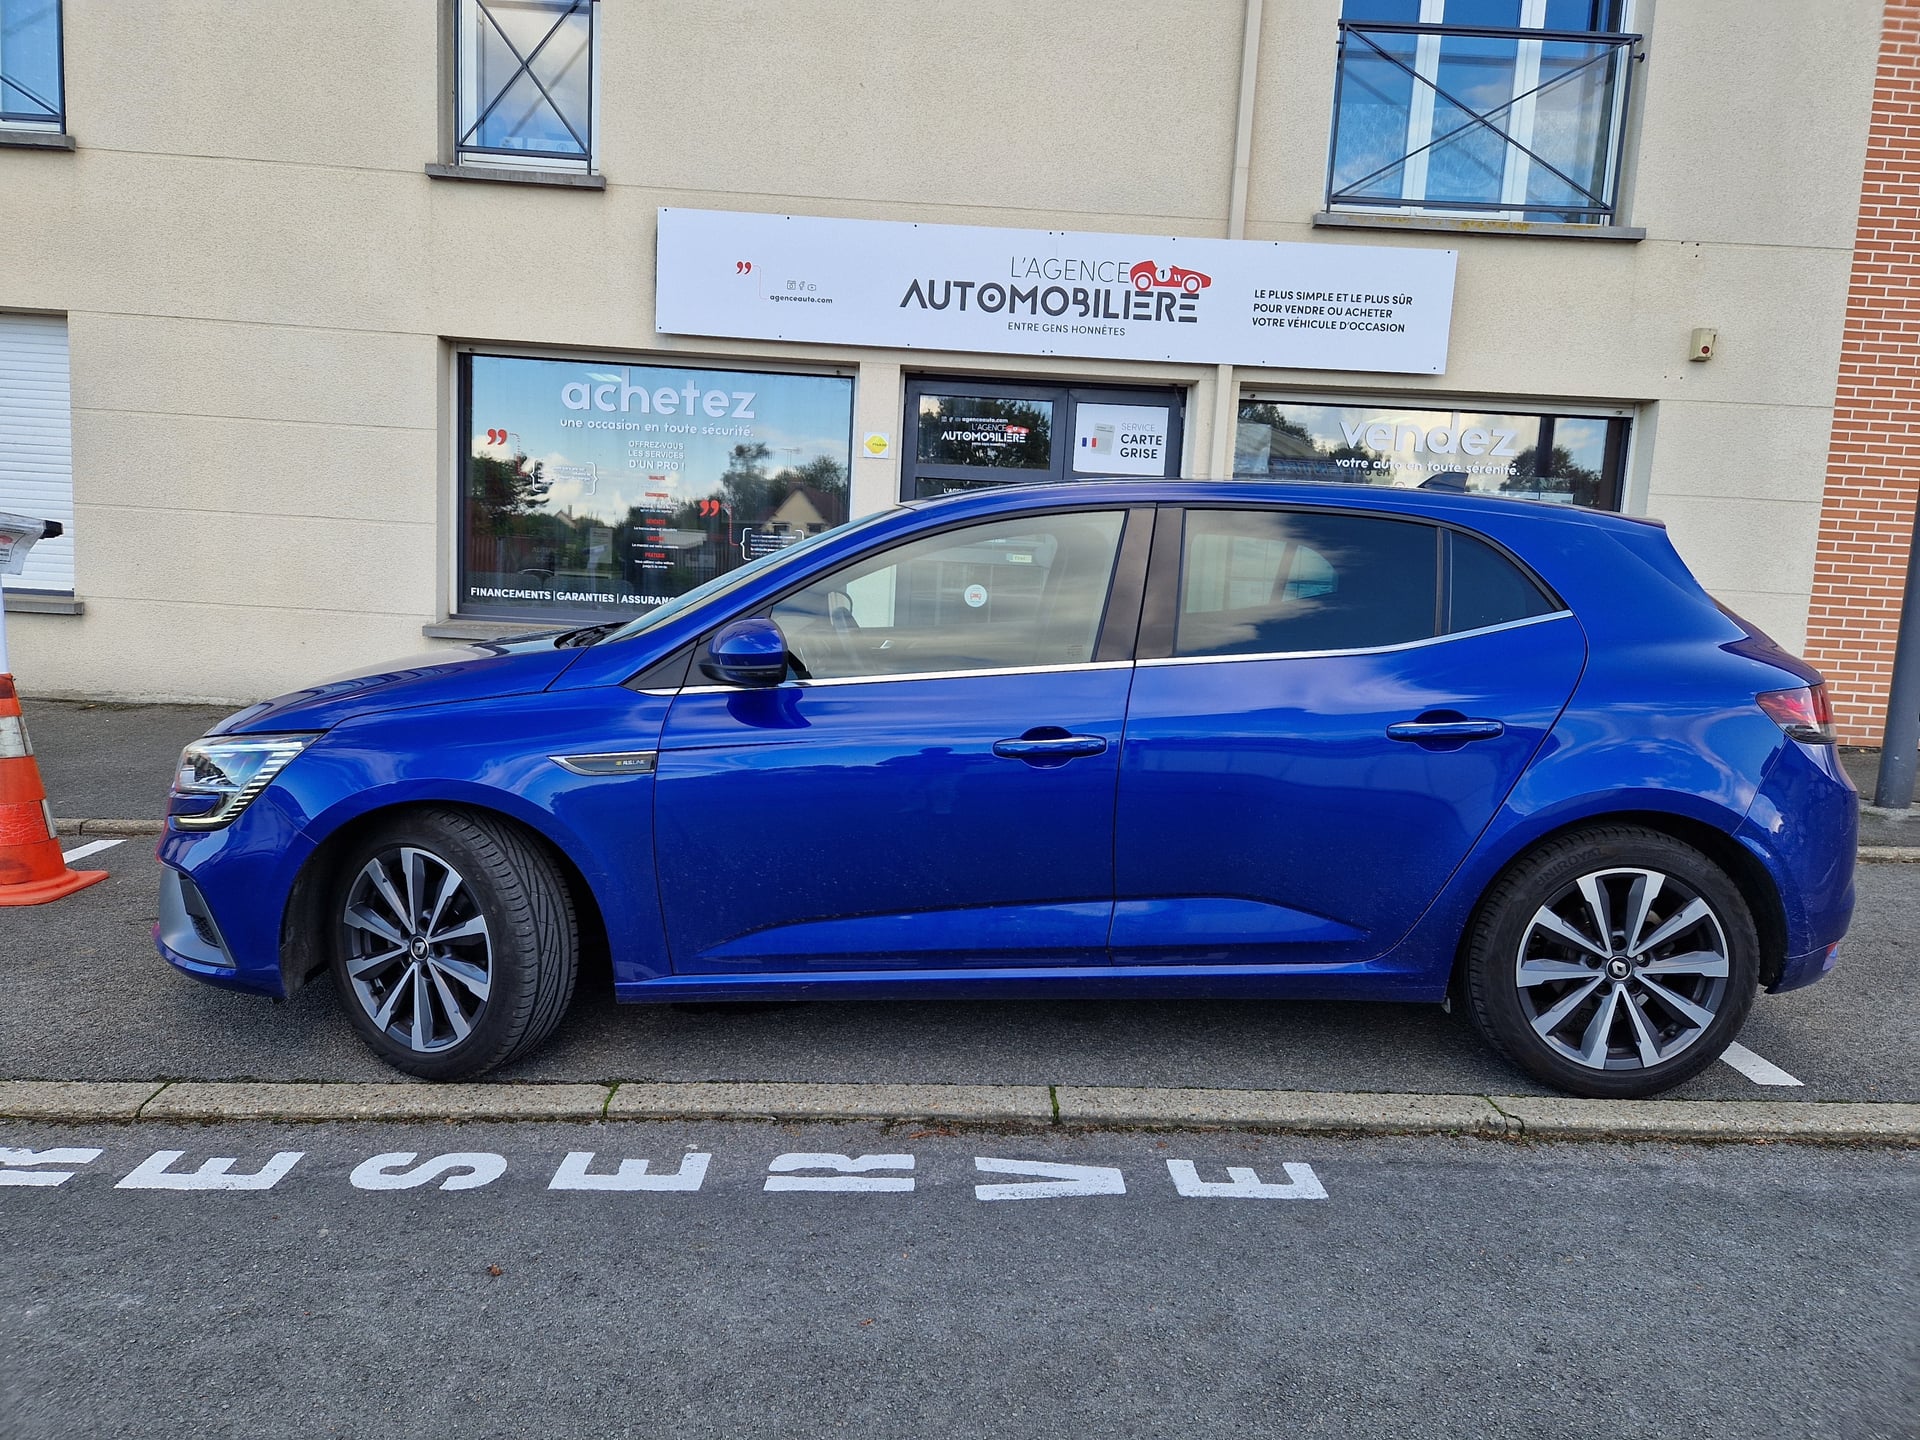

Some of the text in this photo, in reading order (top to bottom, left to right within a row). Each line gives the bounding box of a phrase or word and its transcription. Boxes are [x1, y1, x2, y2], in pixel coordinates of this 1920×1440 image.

[1011, 256, 1130, 284] L'AGENCE
[1159, 269, 1166, 279] 1
[769, 295, 833, 304] agenceauto.com
[1254, 289, 1413, 305] LE PLUS SIMPLE ET LE PLUS SÛR
[1253, 303, 1393, 318] POUR VENDRE OU ACHETER
[1008, 322, 1126, 336] ENTRE GENS HONNÊTES
[1252, 316, 1405, 333] VOTRE VÉHICULE D'OCCASION
[561, 367, 758, 419] achetez
[560, 418, 755, 437] une occasion en toute sécurité.
[971, 423, 1007, 432] L'AGENCE
[1121, 422, 1156, 431] SERVICE
[1339, 410, 1520, 457] vendez
[628, 440, 684, 450] OFFREZ-VOUS
[1120, 433, 1163, 446] CARTE
[628, 449, 684, 459] LES SERVICES
[1120, 447, 1158, 459] GRISE
[628, 460, 654, 469] D'UN
[657, 461, 679, 471] PRO
[1335, 457, 1521, 476] votre auto en toute sérénité.
[470, 587, 551, 600] FINANCEMENTS
[556, 591, 614, 603] GARANTIES
